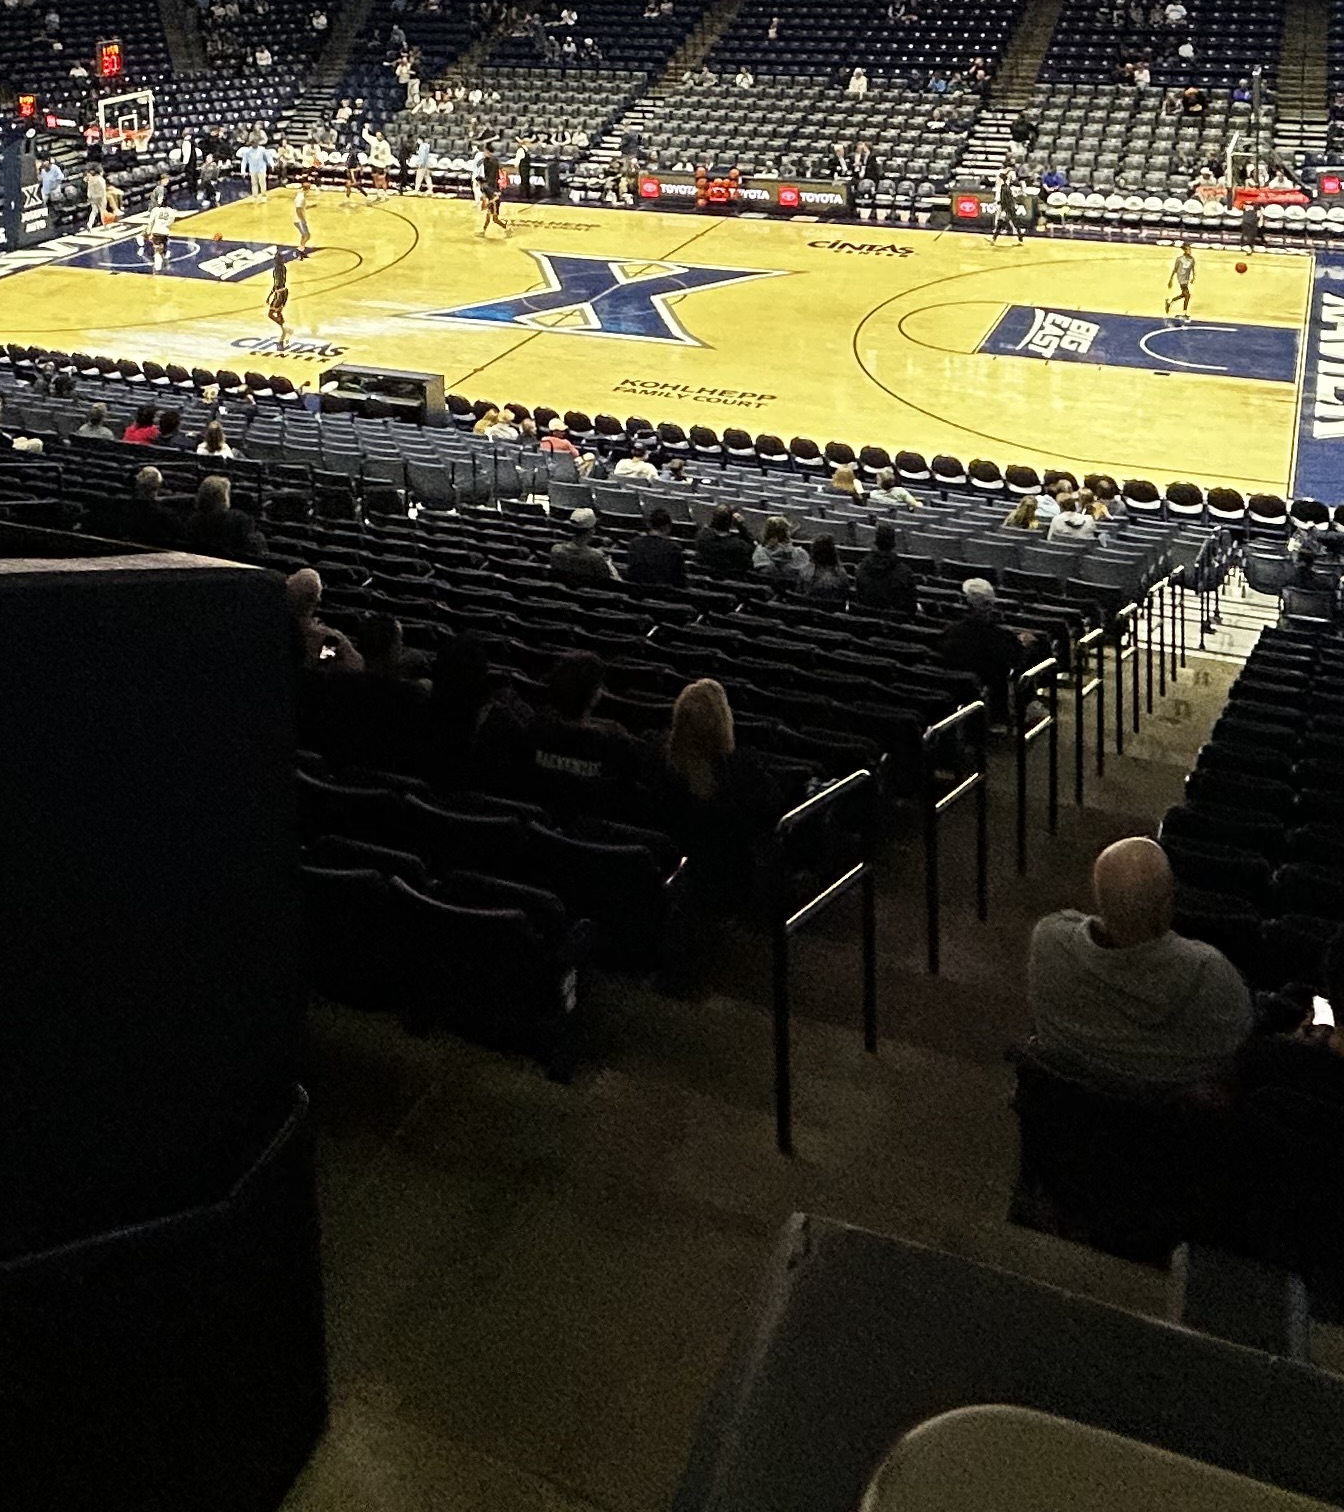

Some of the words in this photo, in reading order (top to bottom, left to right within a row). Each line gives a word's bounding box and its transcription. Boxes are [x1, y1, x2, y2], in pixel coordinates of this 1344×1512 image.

[21, 184, 43, 208] X
[660, 183, 698, 195] TOYOTA
[800, 192, 843, 205] TOYOTA
[1027, 312, 1073, 359] EAST
[1060, 318, 1100, 354] BIG
[612, 386, 690, 400] FAMILY
[693, 395, 768, 409] COURT
[620, 378, 778, 401] KOHLHEPP
